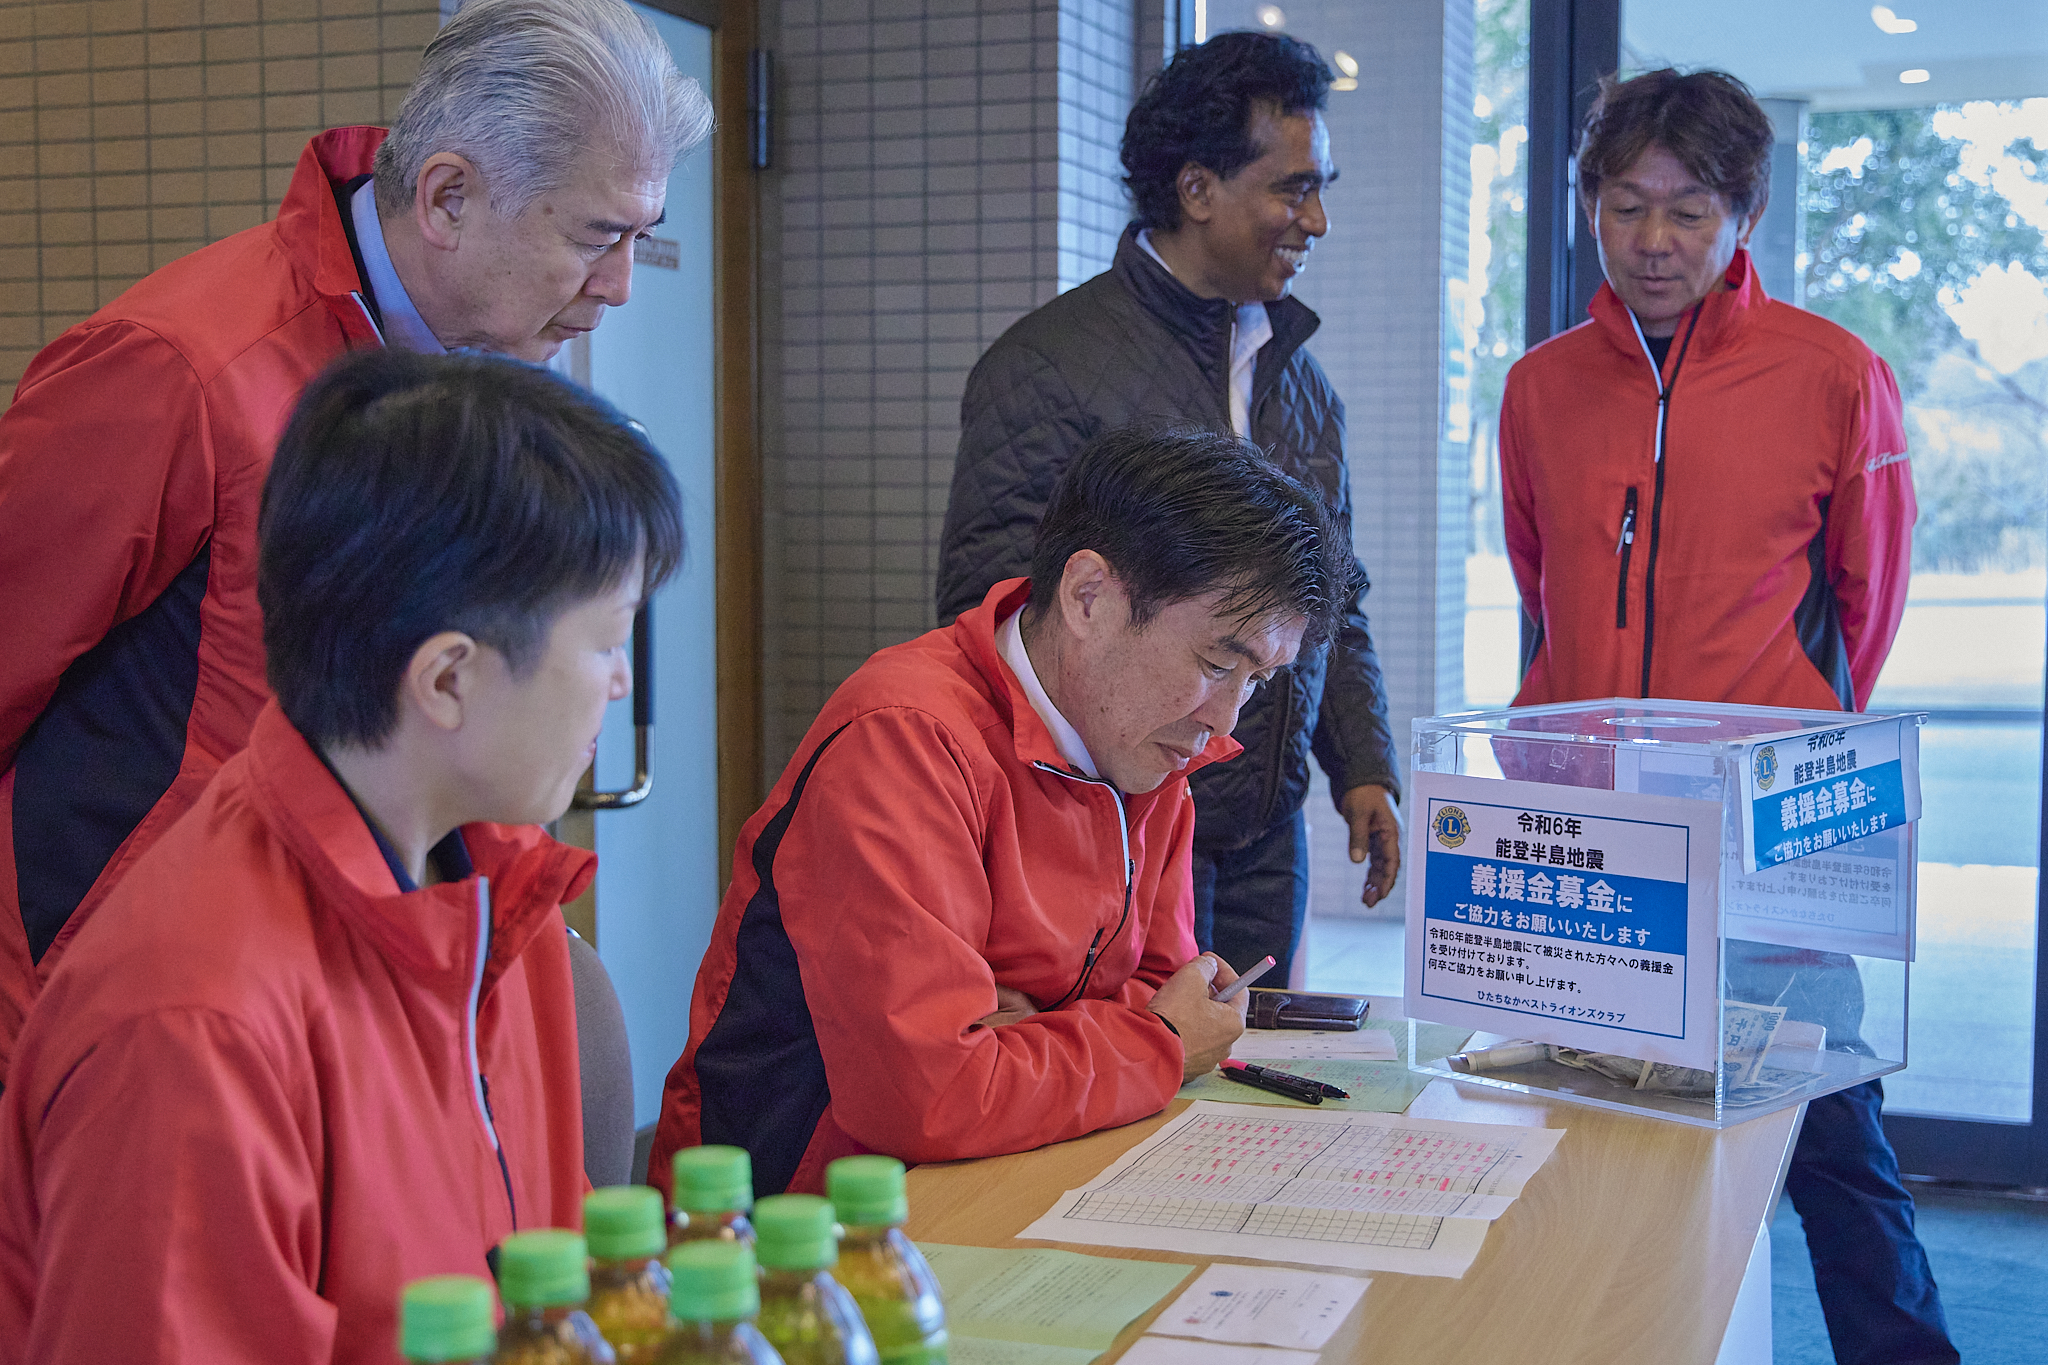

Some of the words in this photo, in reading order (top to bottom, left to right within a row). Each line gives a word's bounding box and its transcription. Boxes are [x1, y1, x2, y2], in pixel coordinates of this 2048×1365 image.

[1793, 748, 1857, 786] 能登半島地震
[1440, 807, 1464, 818] LIONS
[1780, 776, 1877, 832] 義援金募金に
[1447, 819, 1458, 834] L
[1517, 812, 1582, 839] 令和6年
[1773, 811, 1889, 863] ご協力をお願いいたします
[1495, 838, 1604, 871] 能登半島地震
[1471, 863, 1633, 914] 義援金募金に
[1453, 903, 1651, 947] ご協力をお願いいたします
[1429, 927, 1674, 975] 令和6年能登半島地震にて被災された方々への義援金
[1429, 943, 1531, 970] を受け付けております。
[1428, 958, 1583, 994] 何卒ご協力をお願い申し上げます。
[1477, 990, 1626, 1024] ひたちなかベストライオンズクラブ
[1764, 1012, 1781, 1031] 1000
